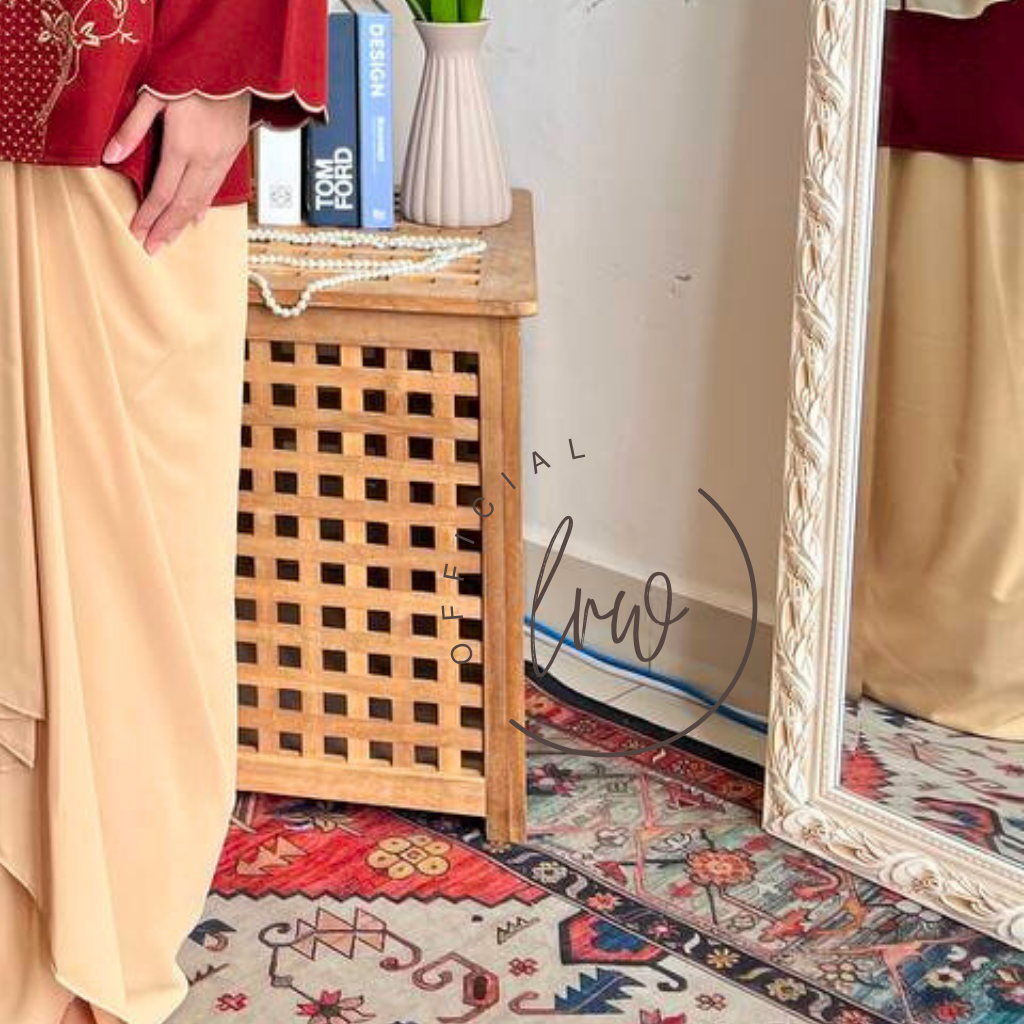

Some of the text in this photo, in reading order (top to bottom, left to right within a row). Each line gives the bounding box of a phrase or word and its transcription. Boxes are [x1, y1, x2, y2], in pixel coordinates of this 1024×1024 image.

[369, 24, 386, 98] DESIGN
[315, 158, 334, 210] TOM
[334, 147, 354, 210] FORD
